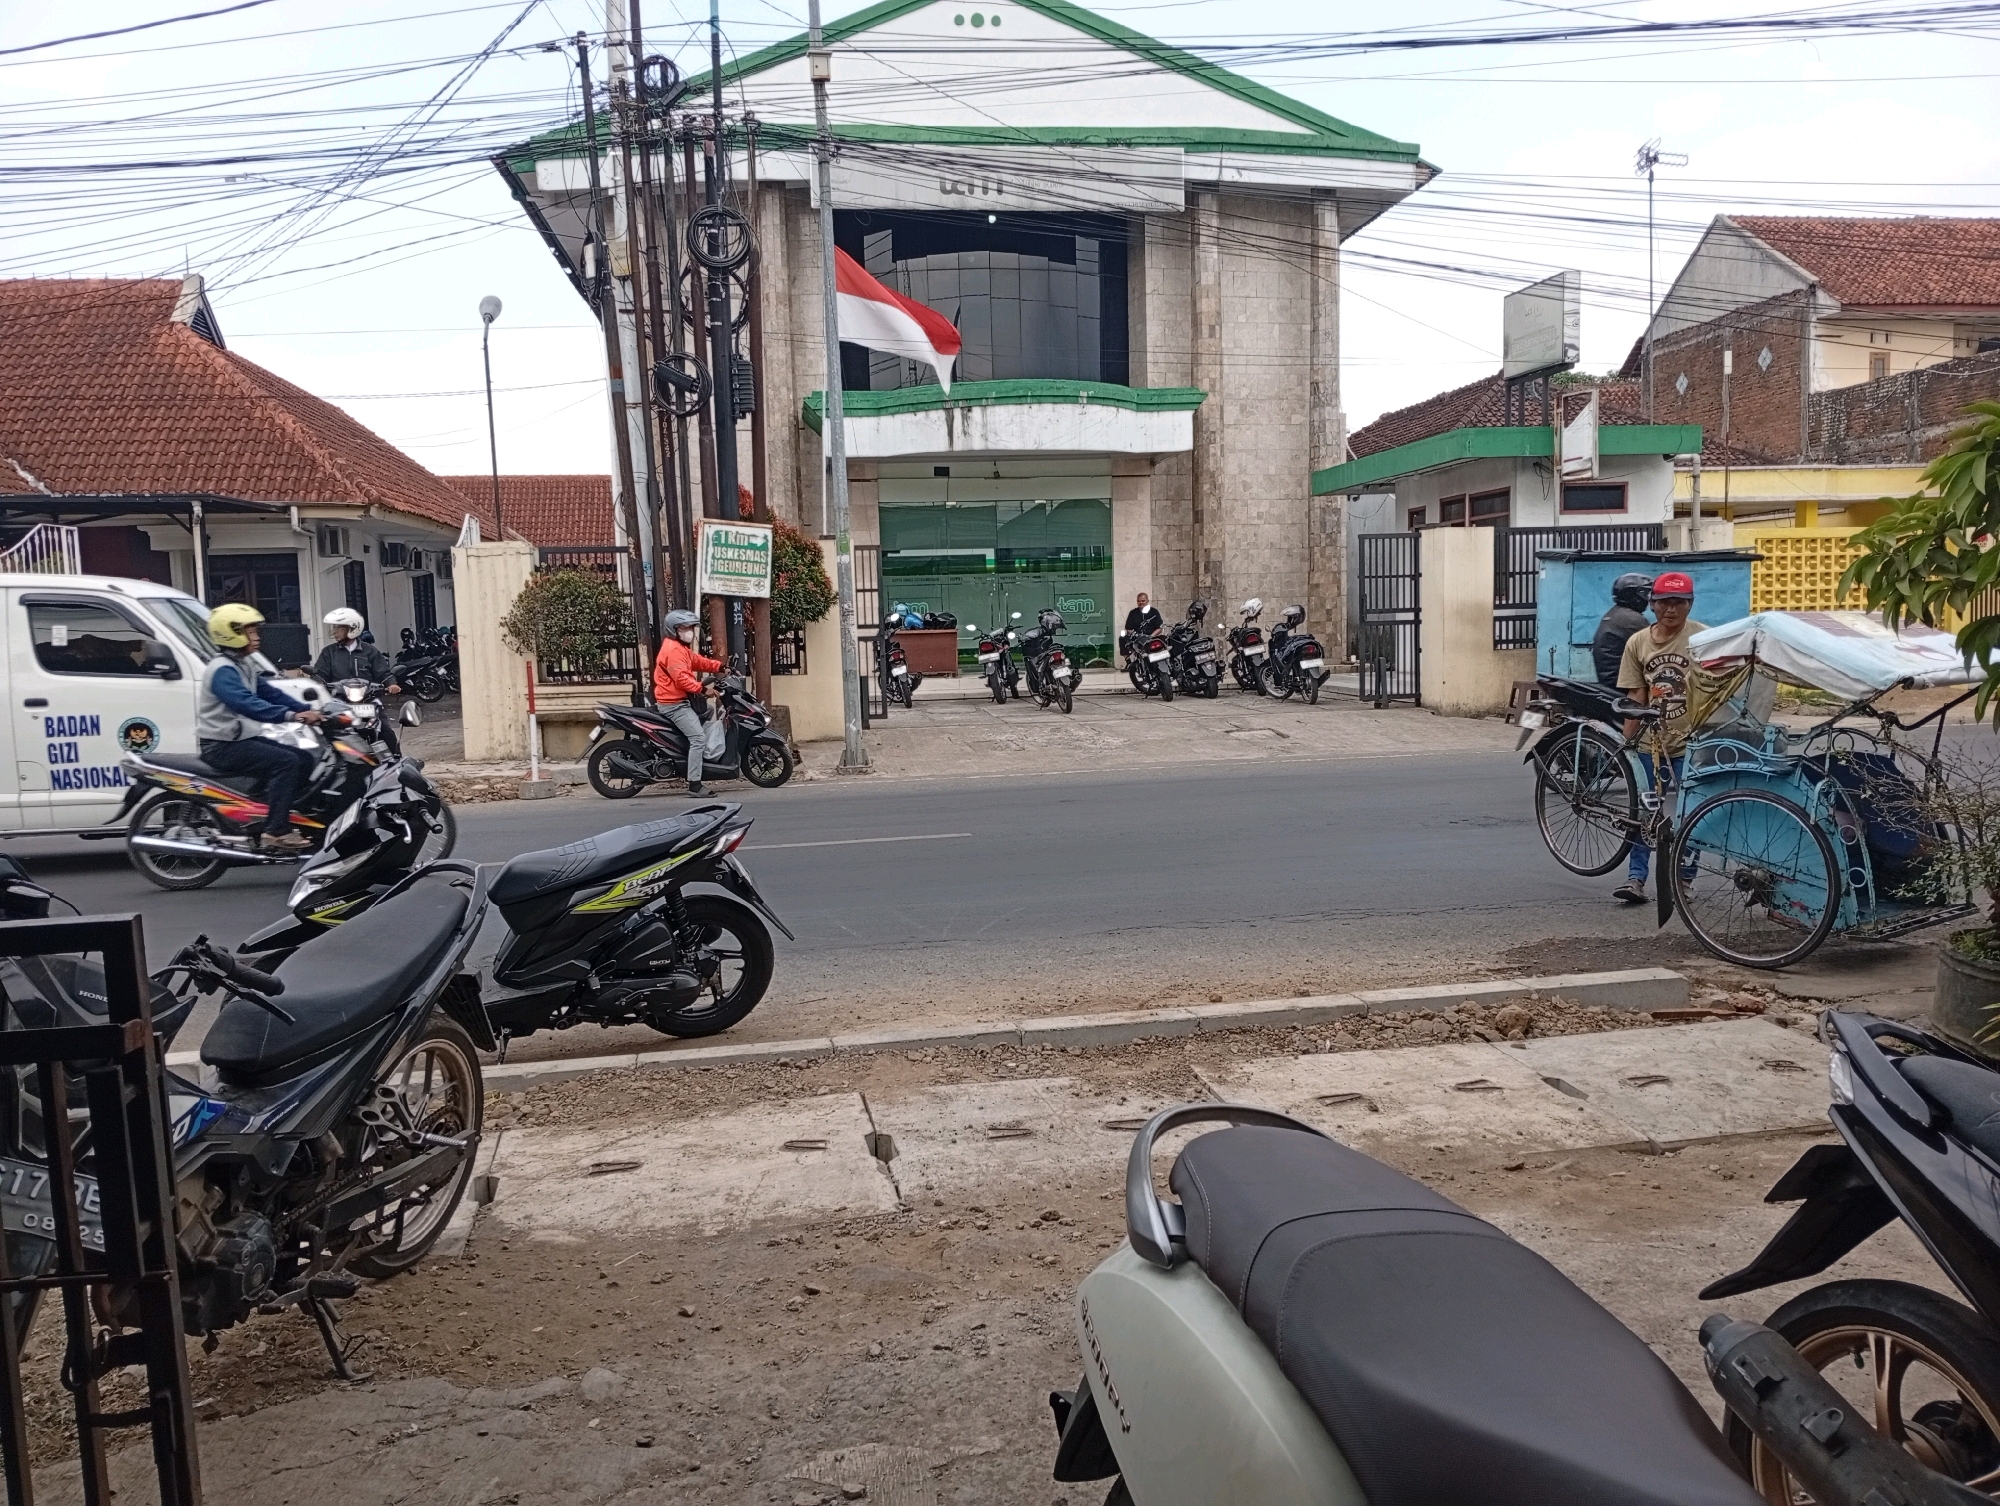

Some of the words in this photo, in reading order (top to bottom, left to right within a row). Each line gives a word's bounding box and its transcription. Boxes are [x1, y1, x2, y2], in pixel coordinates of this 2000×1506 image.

[713, 547, 767, 563] USKESMAS
[1650, 654, 1684, 669] CUSTOM
[44, 714, 101, 738] BADAN
[47, 742, 80, 764] GIZI
[50, 766, 132, 791] NASIONAL
[313, 899, 347, 913] HONDA
